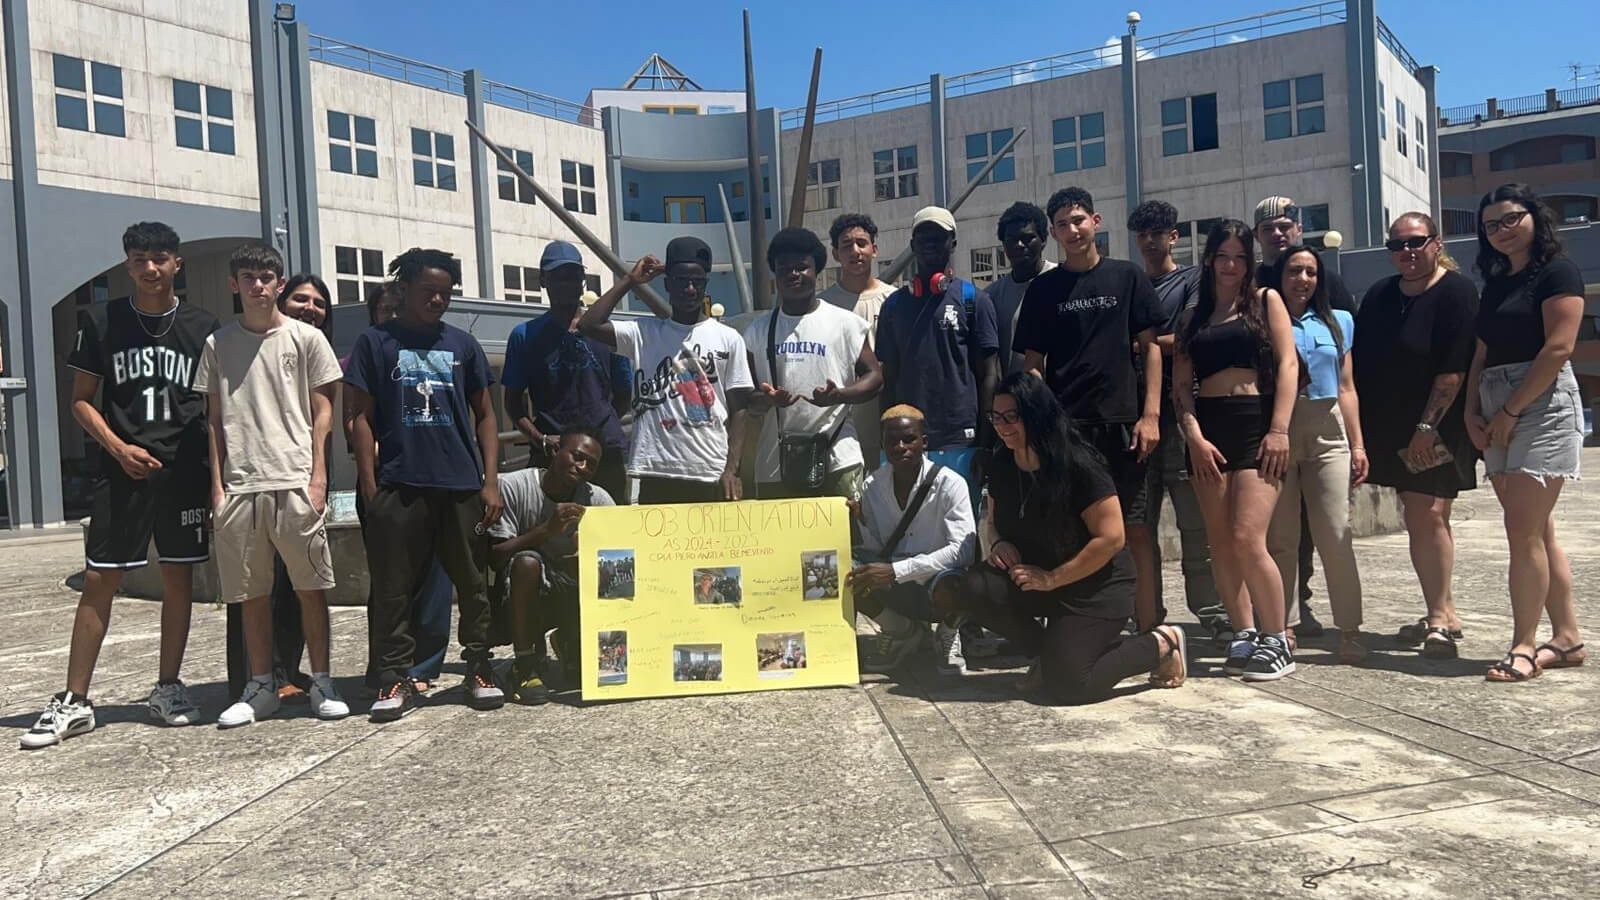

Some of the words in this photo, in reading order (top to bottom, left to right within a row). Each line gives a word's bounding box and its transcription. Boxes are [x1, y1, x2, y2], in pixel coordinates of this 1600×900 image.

[775, 341, 826, 357] ROOKLYN
[112, 346, 192, 388] BOSTON
[142, 387, 171, 421] 11
[631, 507, 679, 537] JOB
[687, 501, 832, 535] ORIENTATION
